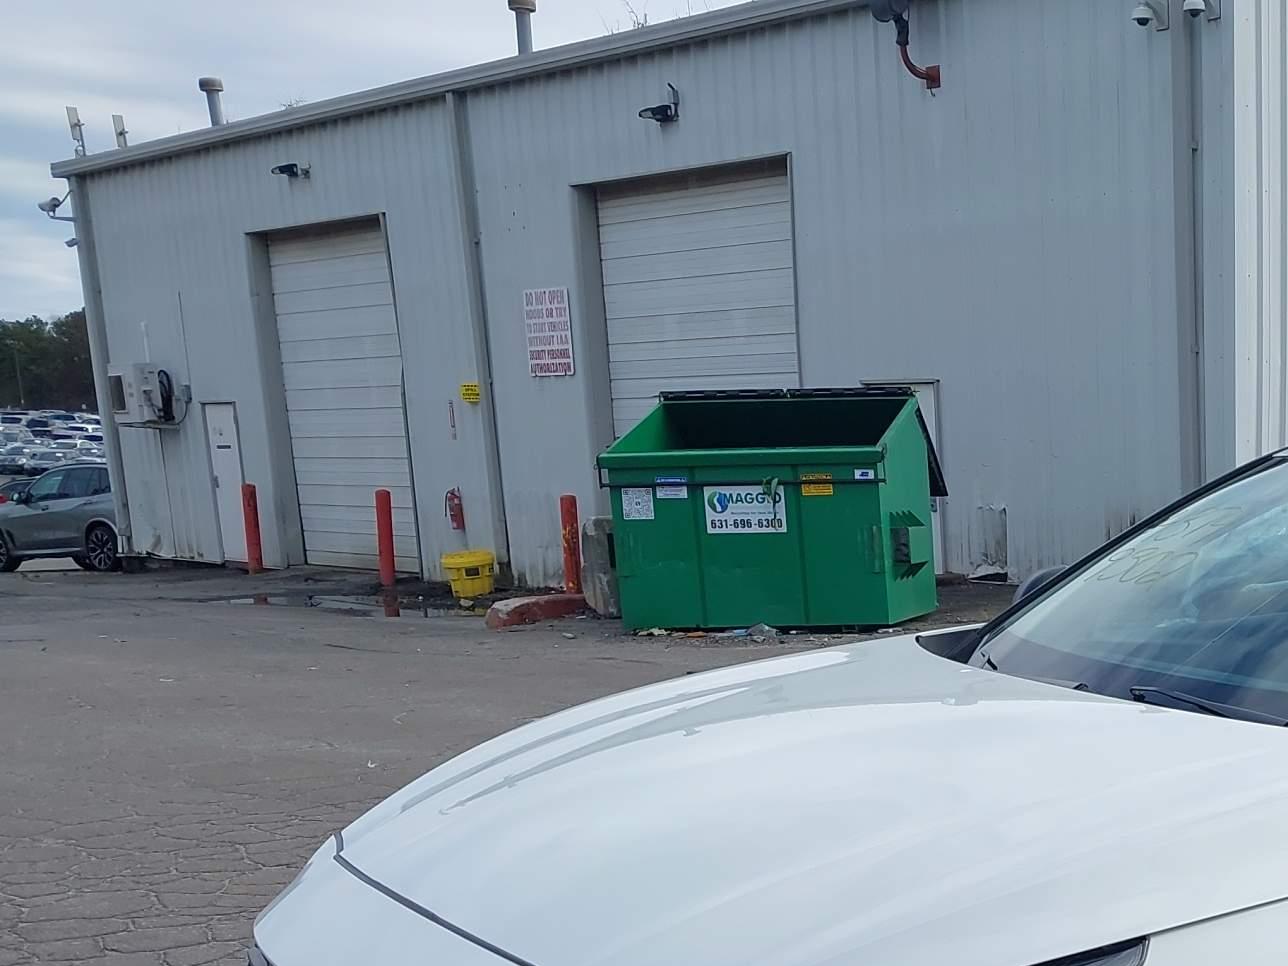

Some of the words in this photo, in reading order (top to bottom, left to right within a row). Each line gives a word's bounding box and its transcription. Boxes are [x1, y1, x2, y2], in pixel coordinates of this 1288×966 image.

[525, 291, 534, 307] DO
[534, 290, 547, 306] NOT
[548, 289, 565, 305] OPEN
[545, 307, 554, 319] OR
[554, 306, 567, 318] TRY
[547, 320, 569, 333] VEHICLES
[528, 335, 555, 347] WITHOUT
[529, 349, 547, 361] SECURITY
[547, 348, 571, 360] PERSONNEL
[530, 361, 572, 374] AUTHORIZATION
[723, 492, 782, 504] MAGGO
[710, 518, 783, 529] 631-696-6300
